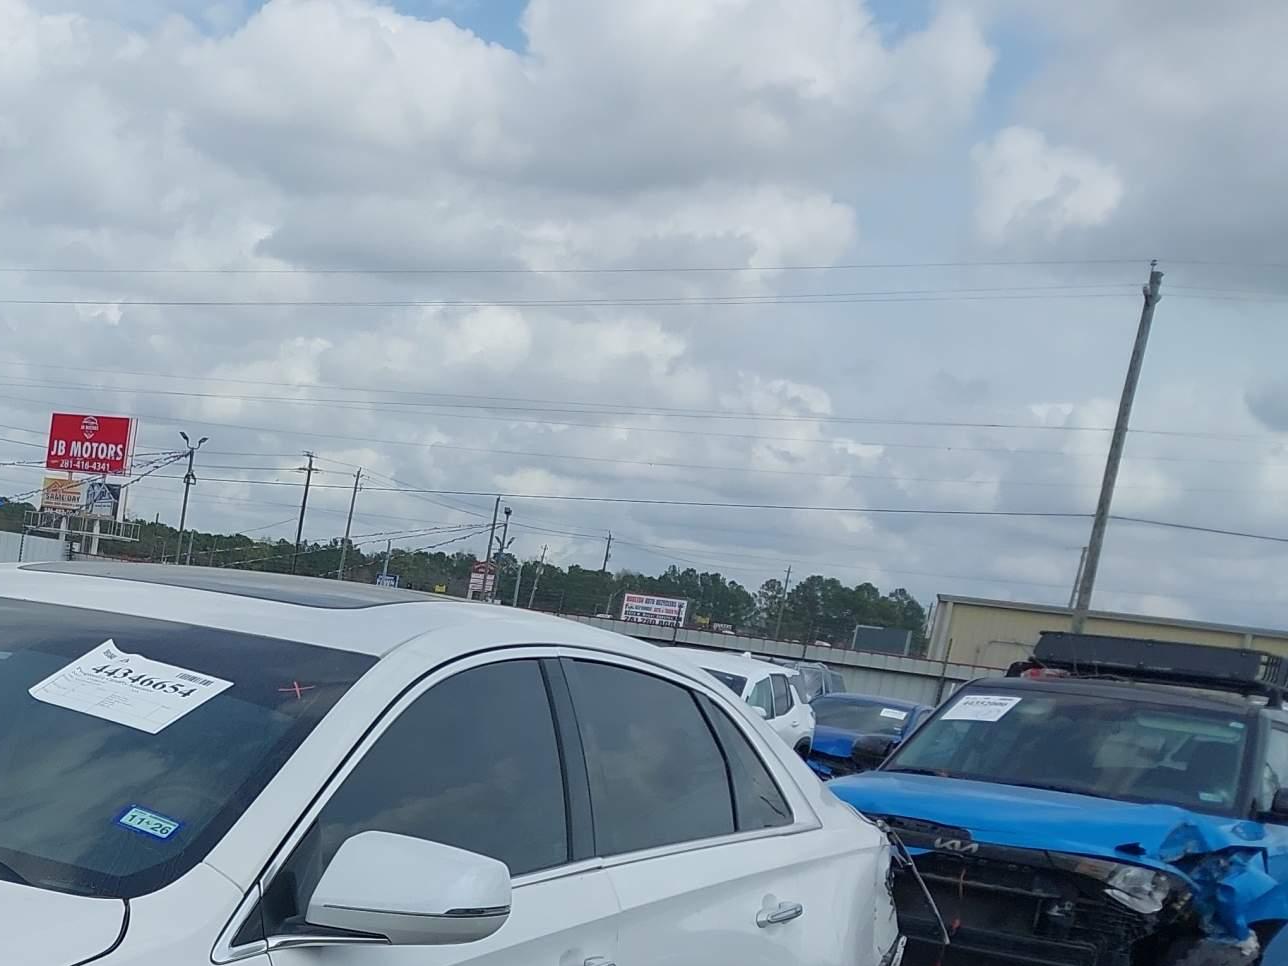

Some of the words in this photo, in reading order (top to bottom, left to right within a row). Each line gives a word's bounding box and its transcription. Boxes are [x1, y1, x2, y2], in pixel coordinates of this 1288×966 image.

[51, 440, 66, 456] JB
[70, 441, 123, 460] MOTORS
[92, 664, 198, 697] 44346654
